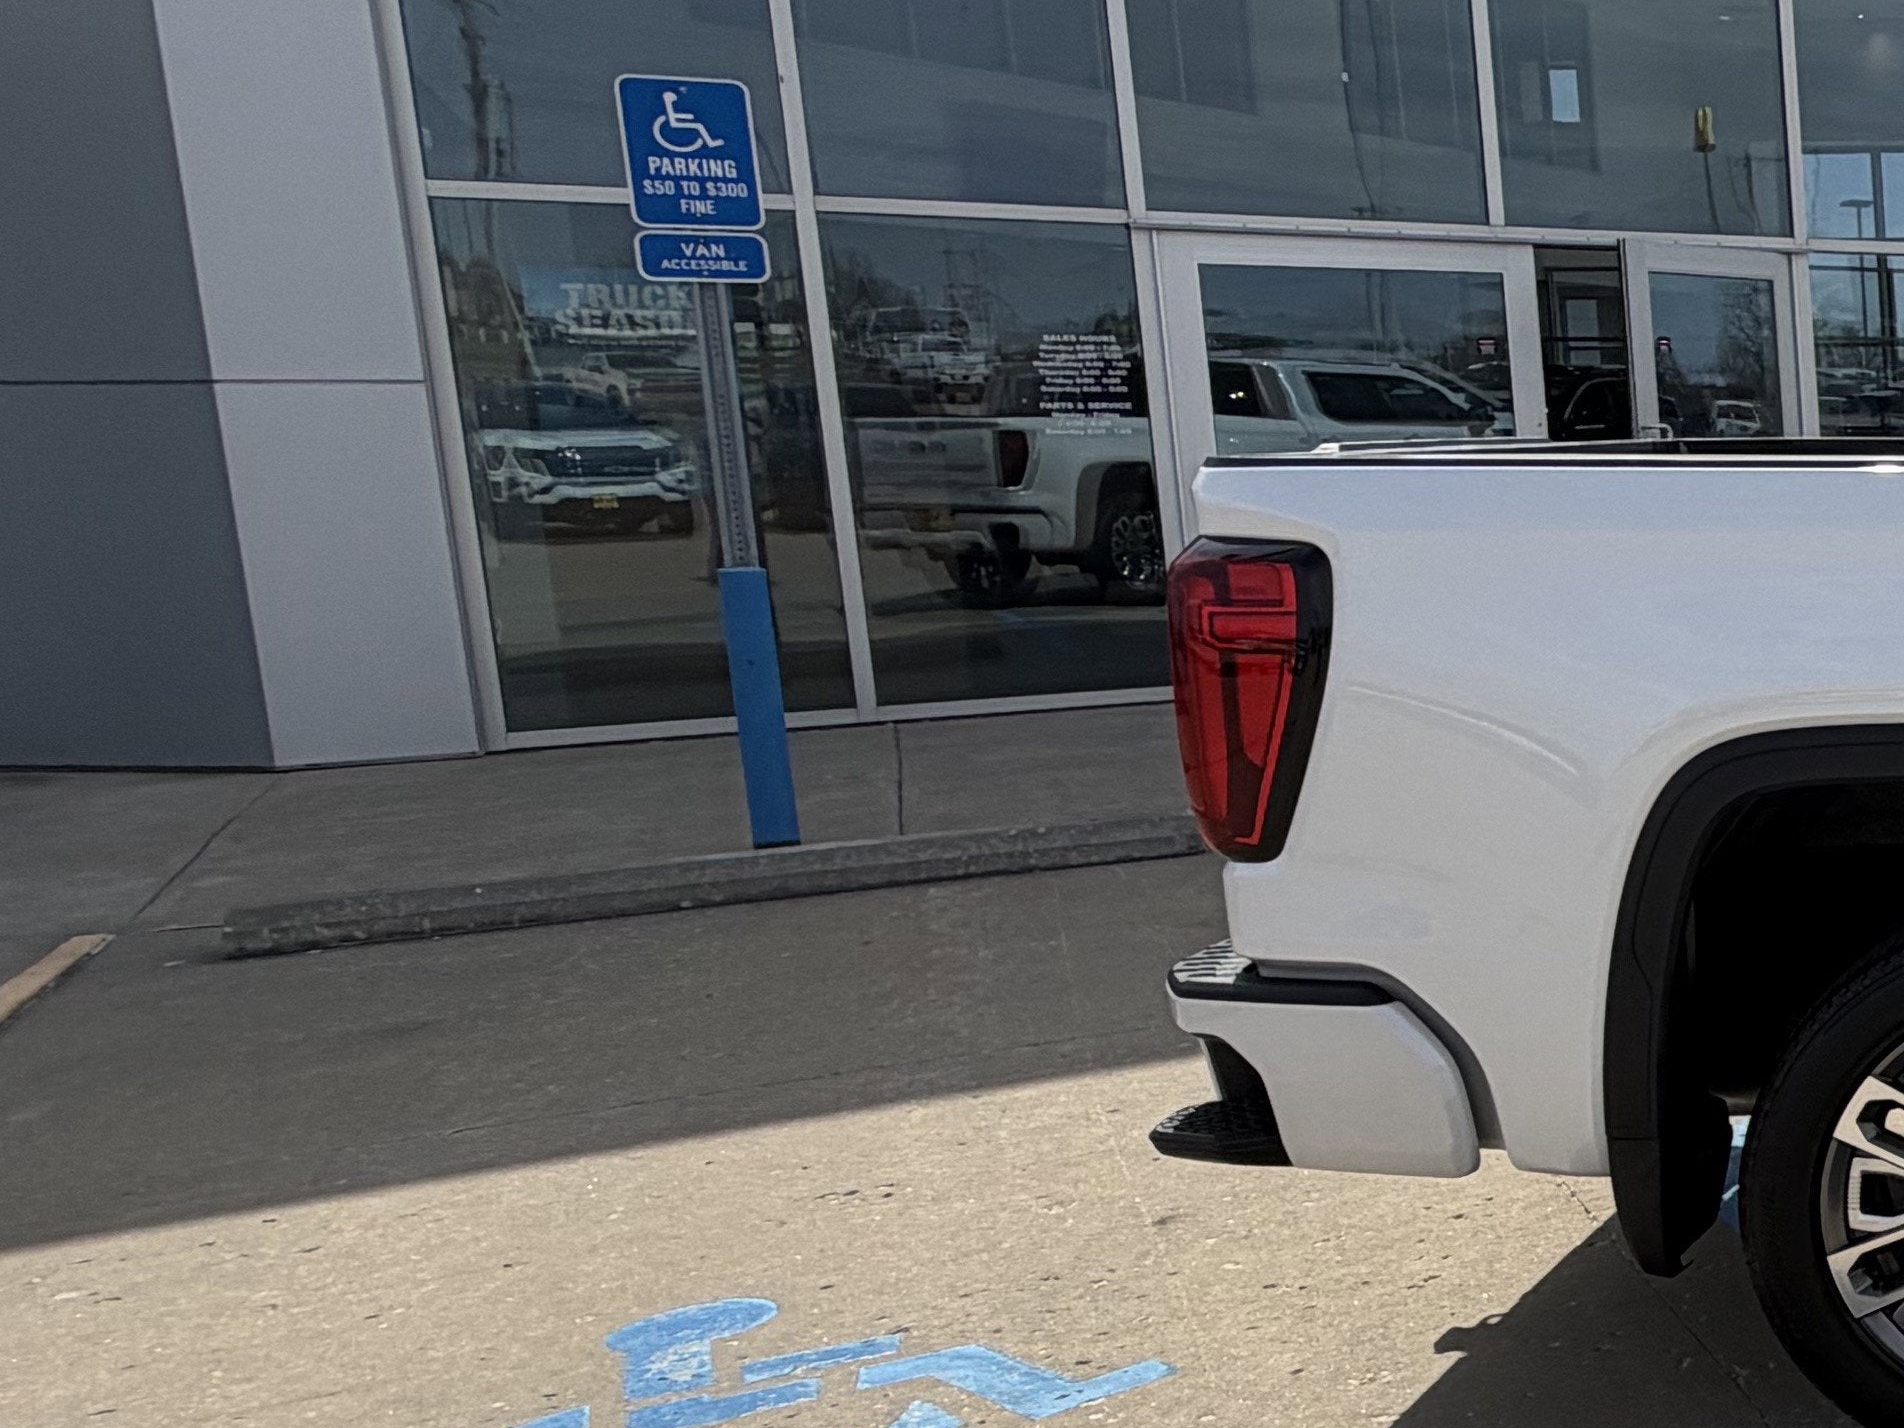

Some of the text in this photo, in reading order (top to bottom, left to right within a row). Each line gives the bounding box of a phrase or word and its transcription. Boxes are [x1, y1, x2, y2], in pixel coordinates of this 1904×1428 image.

[647, 156, 738, 179] PARKING
[642, 179, 749, 198] $50 TO $300
[679, 198, 717, 216] FINE
[680, 242, 726, 259] VAN
[661, 258, 749, 272] ACCESSIBLE
[559, 282, 693, 310] TRUCK
